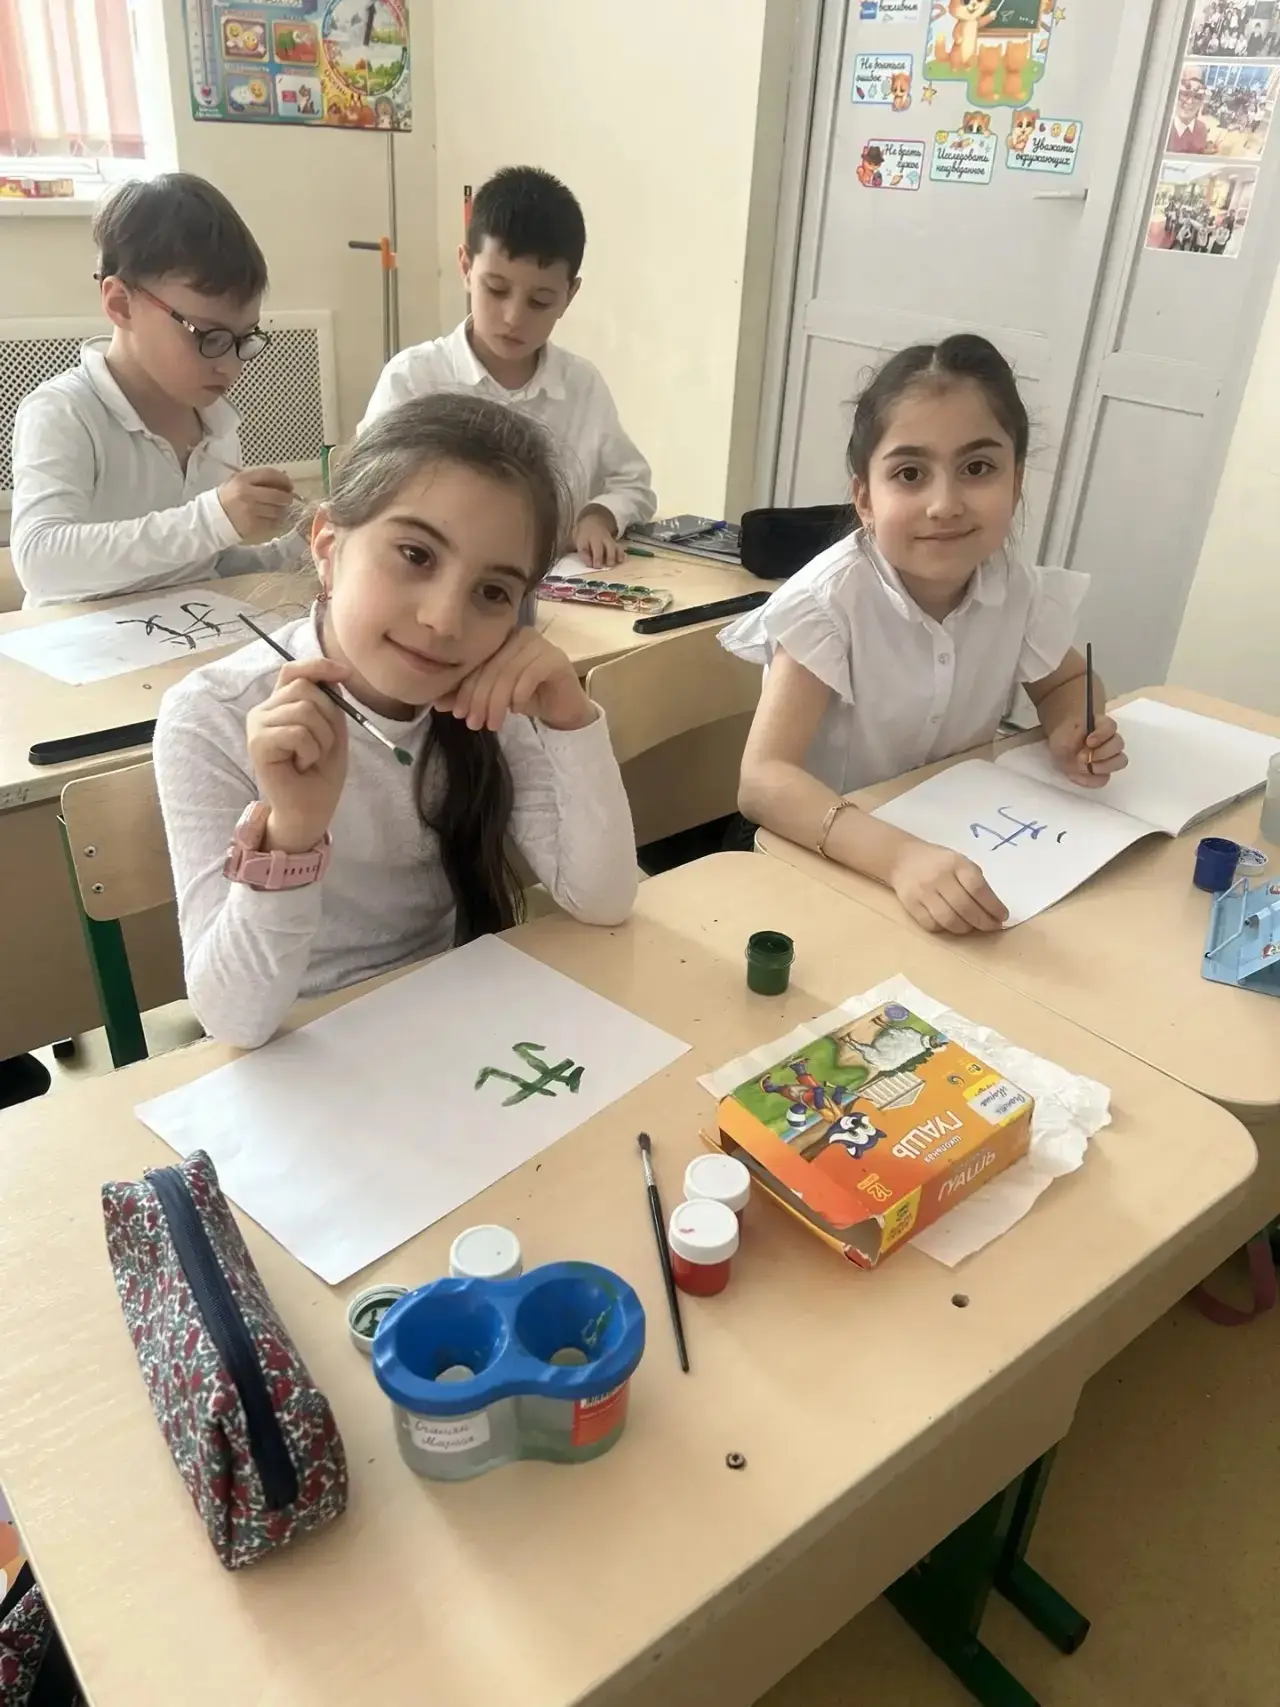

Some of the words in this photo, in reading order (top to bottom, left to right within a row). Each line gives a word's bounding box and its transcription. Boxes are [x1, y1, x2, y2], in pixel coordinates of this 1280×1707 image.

[860, 57, 873, 70] Не
[884, 143, 897, 156] Не
[1032, 137, 1075, 153] Уважать
[937, 148, 990, 165] Исследовать
[1015, 152, 1071, 168] окружающих
[936, 163, 986, 179] неизведанное
[892, 1110, 964, 1159] ГУАШЬ
[923, 1134, 962, 1163] школьная
[937, 1151, 997, 1202] ГУАШЬ
[867, 1182, 893, 1202] 12
